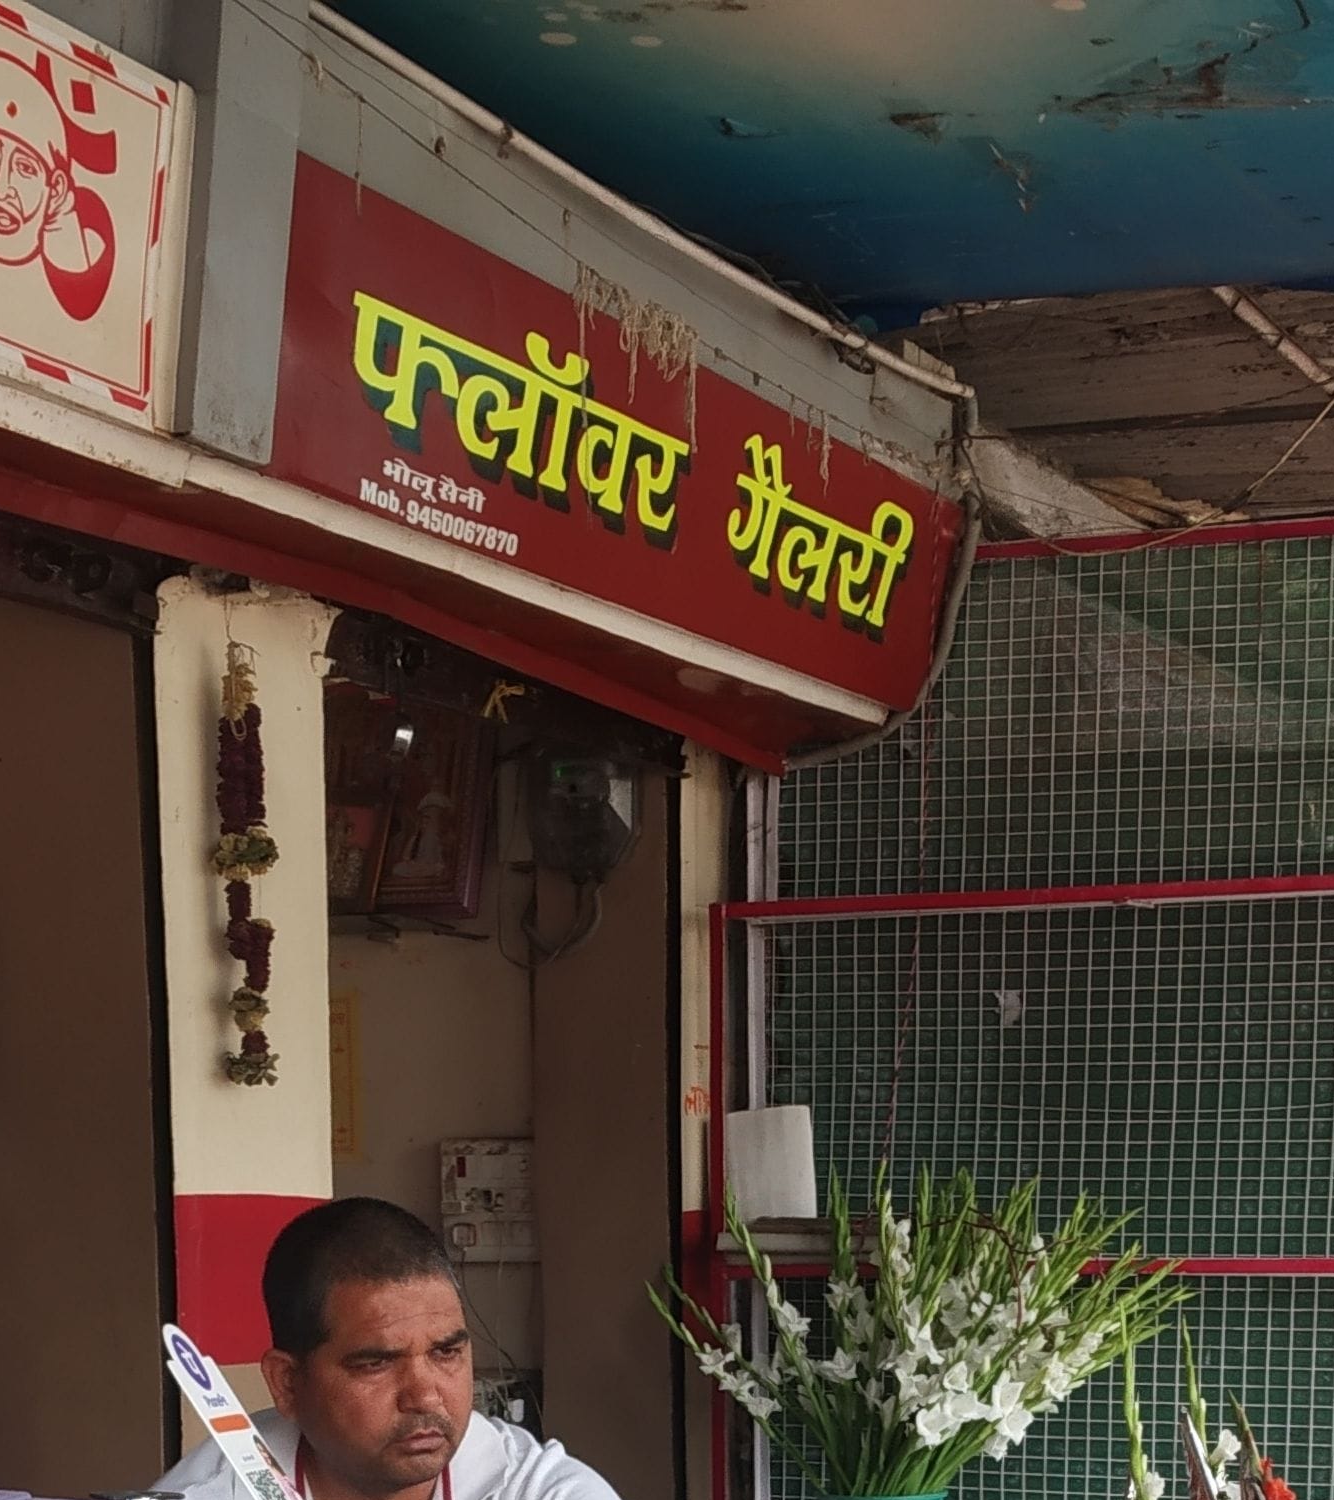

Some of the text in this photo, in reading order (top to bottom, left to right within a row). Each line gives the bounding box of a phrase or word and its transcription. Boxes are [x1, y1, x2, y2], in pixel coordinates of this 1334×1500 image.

[354, 292, 914, 627] फ्लॉवर गैलरी
[437, 474, 487, 514] सैनी
